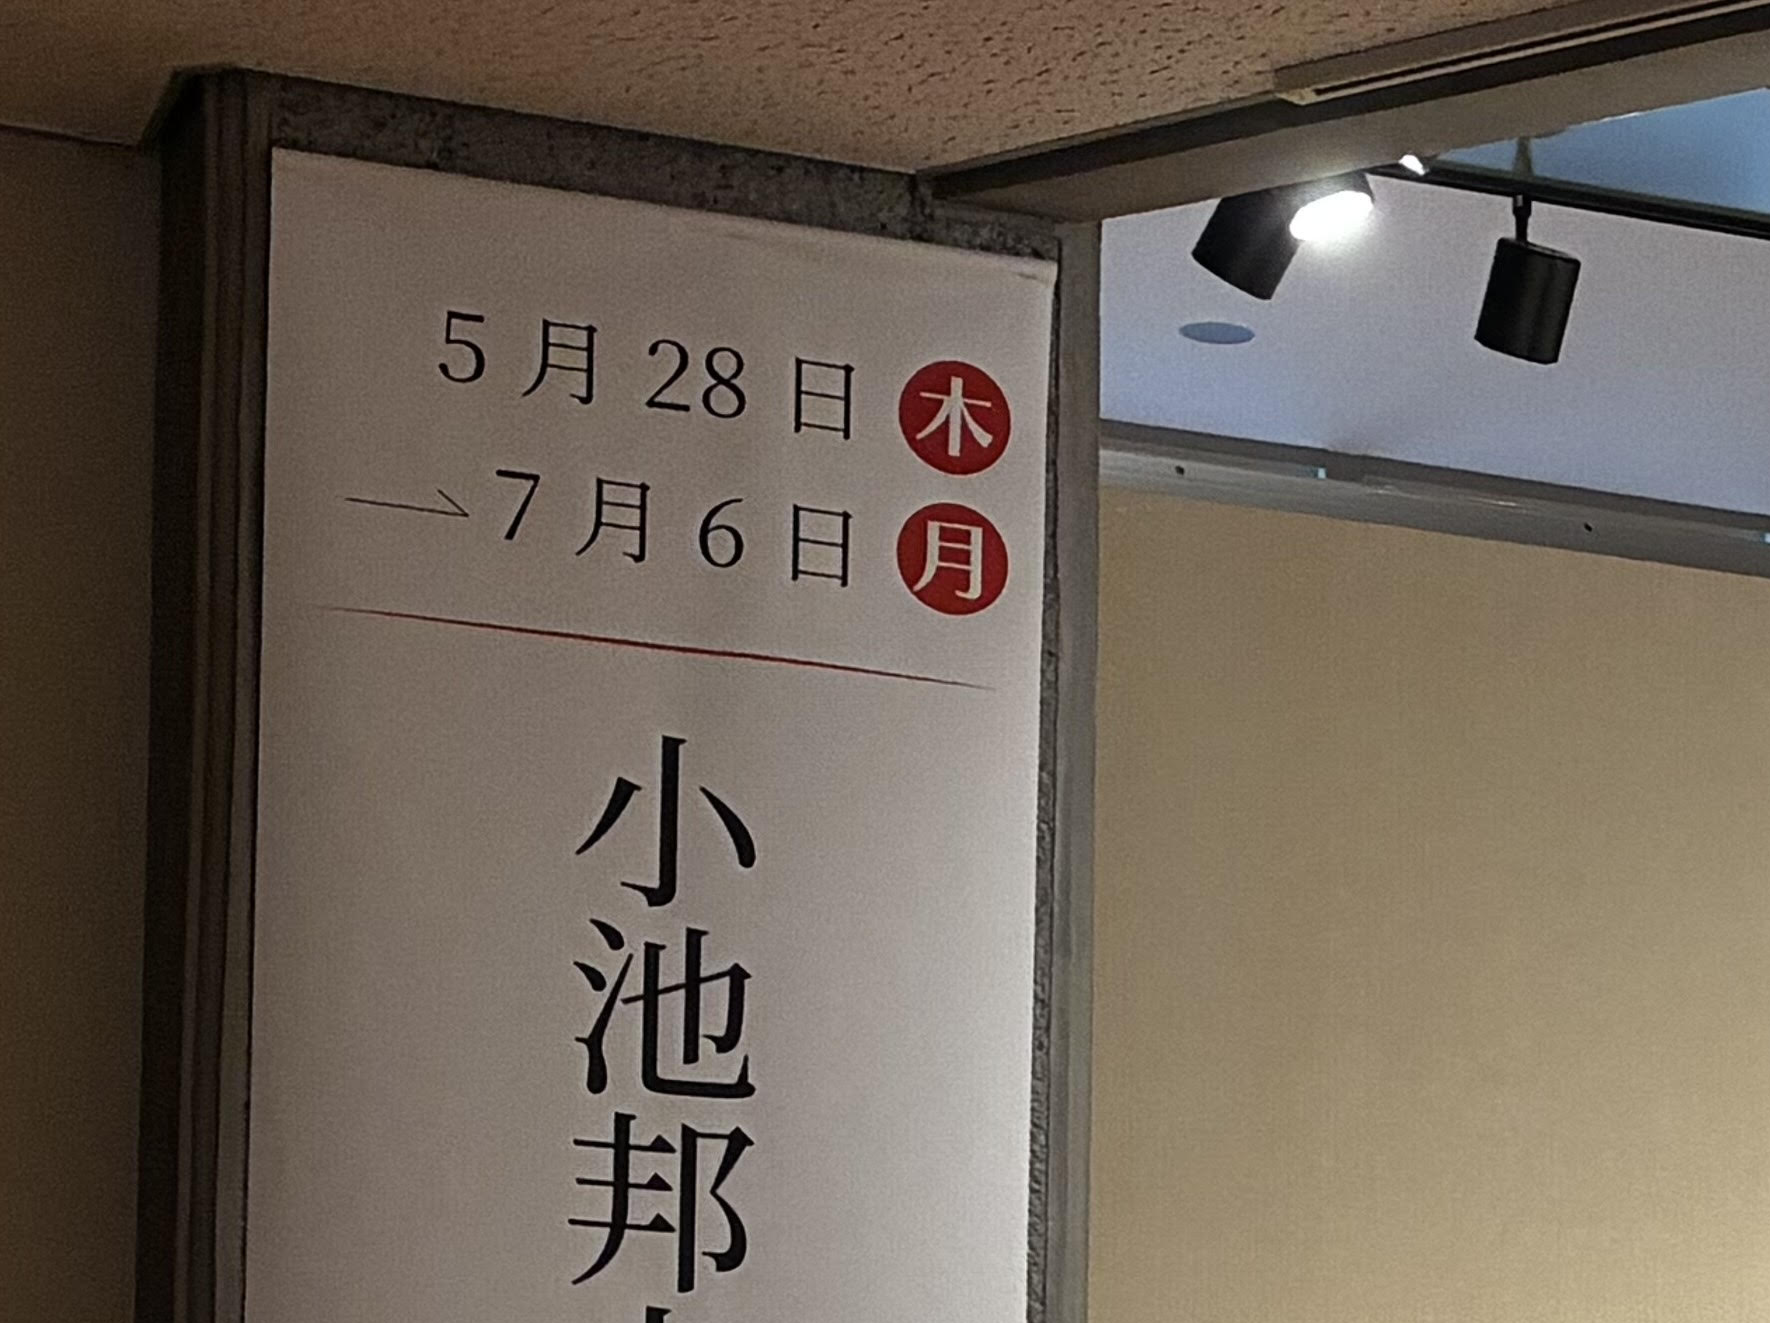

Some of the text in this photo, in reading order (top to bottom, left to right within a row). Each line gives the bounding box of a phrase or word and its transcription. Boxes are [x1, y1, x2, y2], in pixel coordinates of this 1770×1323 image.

[438, 309, 994, 456] 5月28日 木
[495, 468, 984, 600] 7月6日 月
